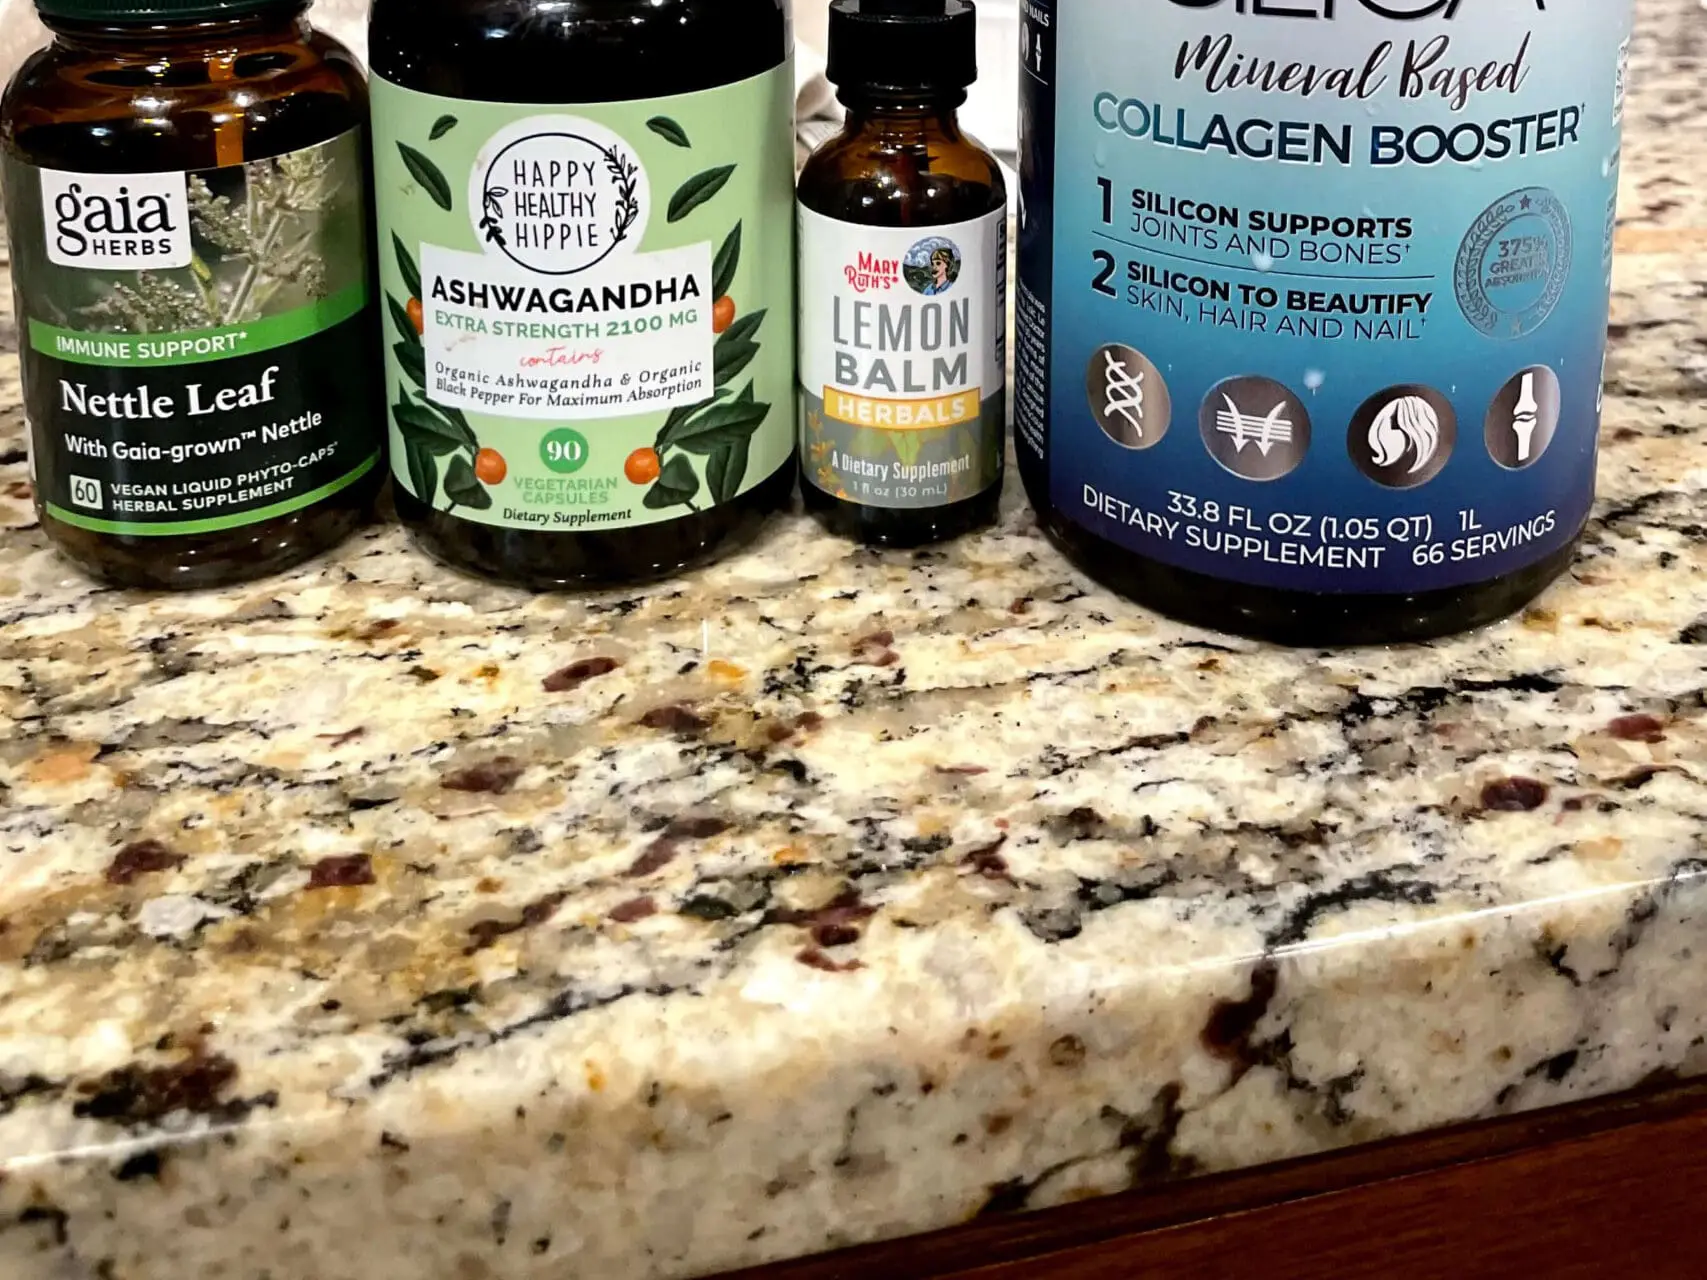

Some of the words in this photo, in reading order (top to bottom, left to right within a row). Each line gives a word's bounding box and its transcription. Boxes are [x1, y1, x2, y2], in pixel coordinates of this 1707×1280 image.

[1174, 33, 1393, 98] Mineral
[1399, 31, 1532, 111] Based
[1093, 90, 1352, 165] COLLAGEN
[513, 159, 596, 187] HAPPY
[514, 191, 597, 219] HEALTHY
[1096, 177, 1113, 224] 1
[1131, 188, 1239, 228] SILICON
[1248, 210, 1413, 240] SUPPORTS
[55, 183, 176, 256] gaia
[516, 223, 598, 249] HIPPIE
[1131, 211, 1219, 252] JOINTS
[1225, 232, 1292, 258] AND
[92, 239, 172, 255] HERBS
[1091, 250, 1118, 298] 2
[1127, 261, 1231, 308] SILICON
[1238, 283, 1278, 309] TO
[1286, 291, 1432, 315] BEAUTIFY
[431, 274, 700, 313] ASHWAGANDHA
[435, 310, 487, 336] EXTRA
[492, 321, 599, 339] STRENGTH
[606, 316, 663, 337] 2100
[669, 310, 698, 329] MG
[833, 295, 969, 352] LEMON
[1127, 284, 1191, 323] SKIN,
[1199, 304, 1270, 334] HAIR
[1276, 313, 1344, 339] AND
[56, 335, 131, 359] IMMUNE
[520, 346, 605, 368] contains
[435, 361, 489, 385] Organic
[495, 373, 613, 392] Ashwagandha
[620, 372, 631, 385] &
[639, 360, 702, 388] Organic
[835, 350, 967, 393] BALM
[59, 378, 174, 418] Nettle
[187, 366, 280, 416] Leaf
[436, 378, 466, 399] Black
[470, 385, 515, 406] Pepper
[519, 392, 541, 406] For
[546, 390, 622, 406] Maximum
[626, 378, 702, 403] Absorption
[837, 398, 965, 425] HERBALS
[64, 433, 108, 460] With
[261, 411, 322, 444] Nettle
[546, 439, 581, 461] 90
[832, 450, 839, 468] A
[842, 453, 888, 481] Dietary
[893, 454, 970, 483] Supplement
[75, 481, 98, 504] 60
[111, 483, 167, 497] VEGAN
[172, 477, 231, 494] LIQUID
[112, 499, 177, 512] HERBAL
[183, 477, 294, 510] SUPPLEMENT
[513, 476, 618, 491] VEGETARIAN
[522, 491, 608, 505] CAPSULES
[874, 487, 889, 496] oz
[503, 507, 549, 525] Dietary
[553, 508, 632, 525] Supplement
[1083, 484, 1178, 542] DIETARY
[1185, 526, 1385, 569] SUPPLEMENT
[1413, 543, 1444, 567] 66
[1450, 510, 1555, 561] SERVINGS
[1167, 490, 1220, 523] 33.8
[1228, 503, 1260, 531] FL
[1268, 511, 1312, 538] OZ
[1320, 515, 1380, 542] (1.05
[1387, 514, 1432, 543] QT)
[1460, 508, 1482, 532] 1L
